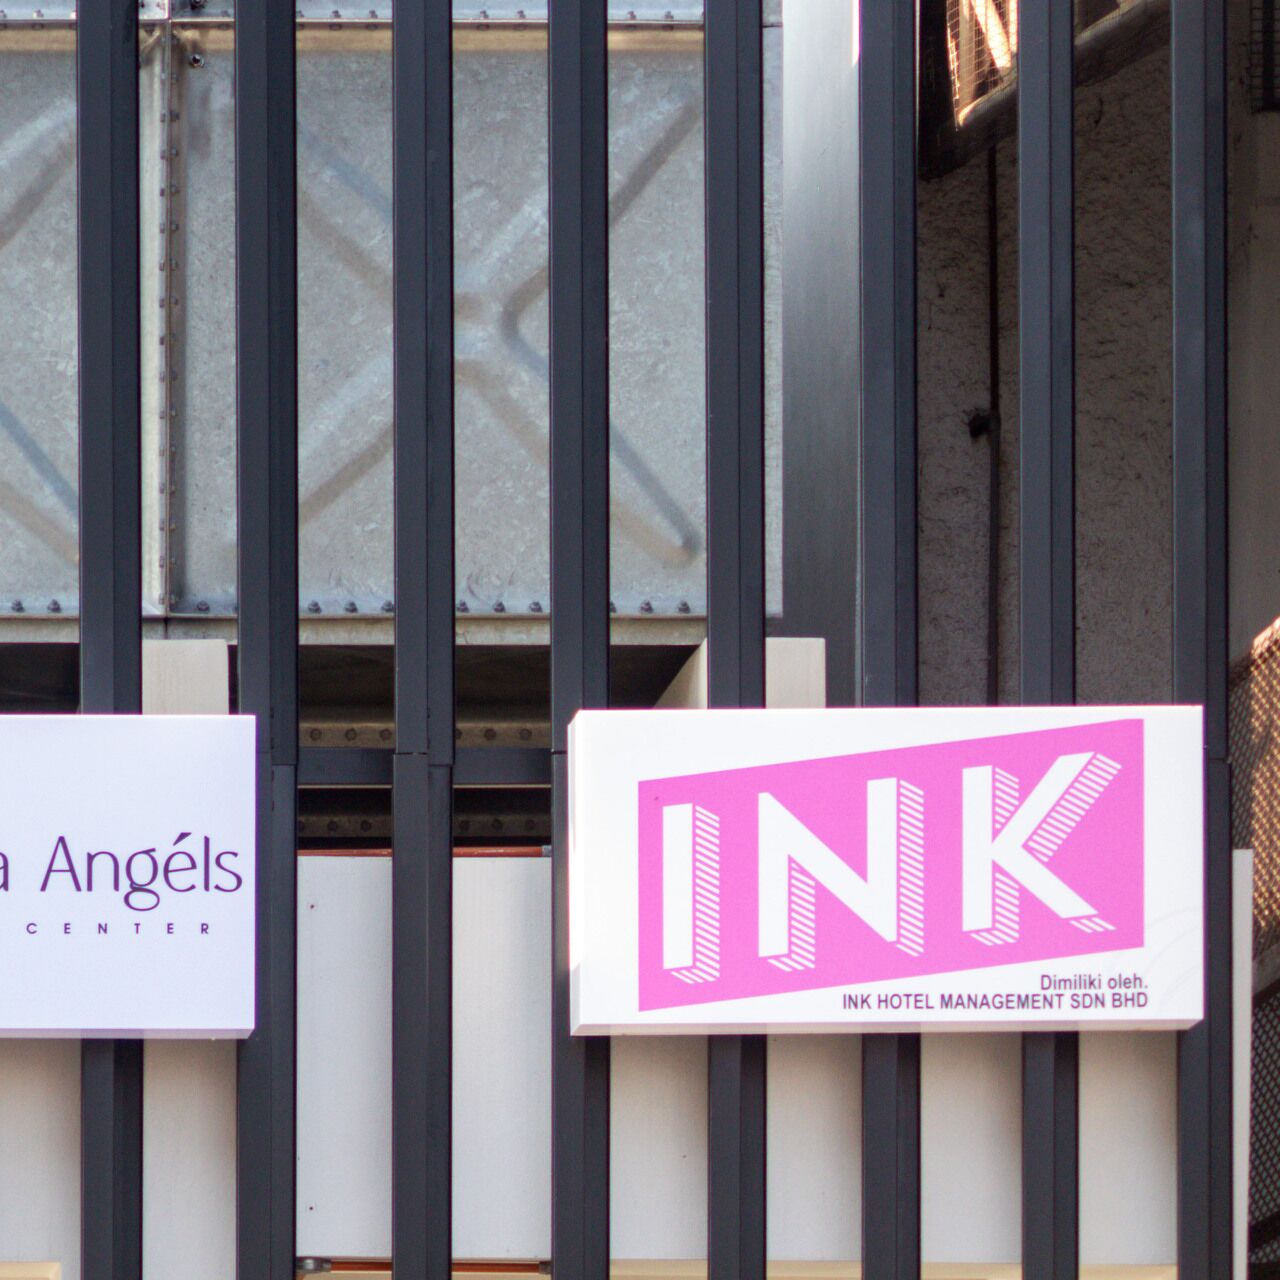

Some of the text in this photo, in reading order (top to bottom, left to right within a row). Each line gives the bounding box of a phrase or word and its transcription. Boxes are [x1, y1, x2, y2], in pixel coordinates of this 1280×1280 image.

[39, 831, 244, 912] Angéls
[662, 752, 1122, 984] INK
[25, 921, 211, 936] CENTER
[1040, 973, 1102, 991] Dimiliki
[842, 991, 1149, 1010] INK HOTEL MANAGEMENT SDN BHD
